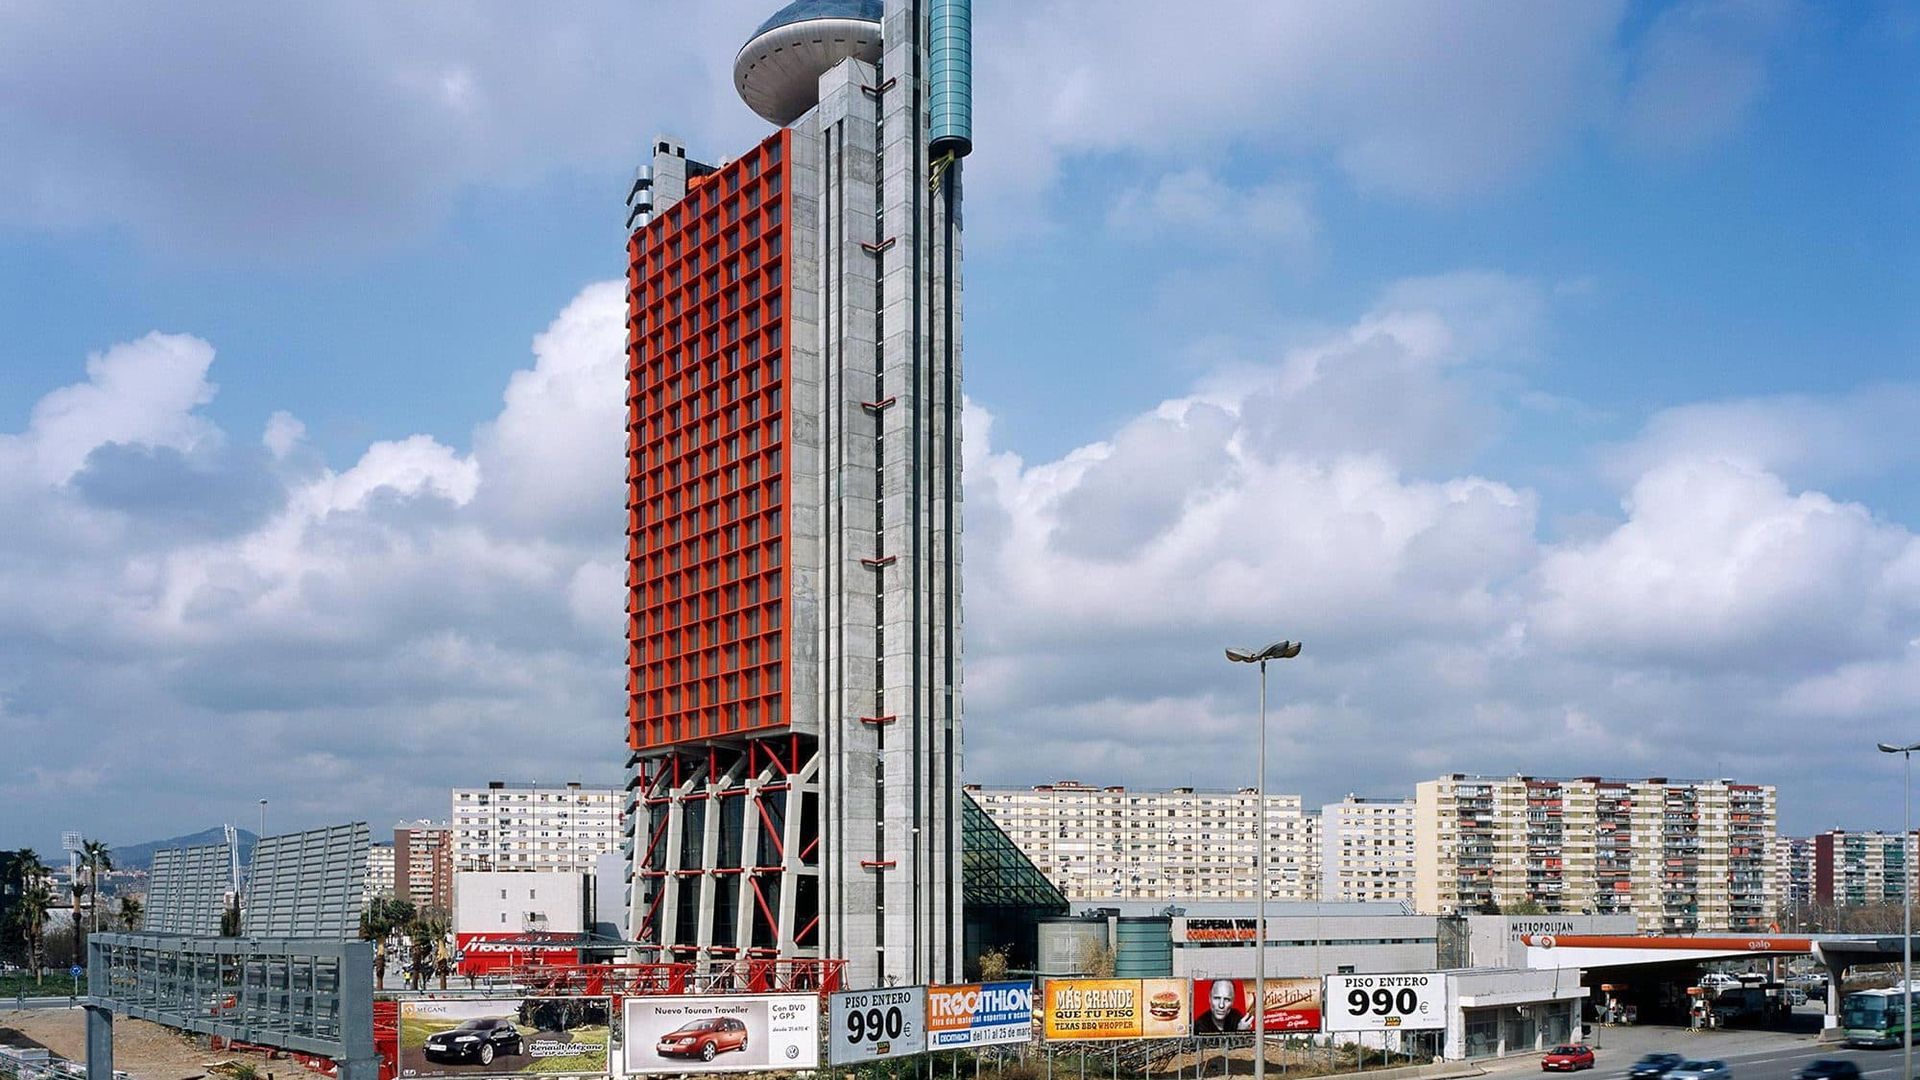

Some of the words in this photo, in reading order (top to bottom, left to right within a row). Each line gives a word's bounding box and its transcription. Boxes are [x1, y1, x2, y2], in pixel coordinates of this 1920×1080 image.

[1187, 919, 1234, 930] HESPERIA
[1235, 919, 1267, 930] TOW
[1511, 922, 1574, 933] METROPOLITAN
[1748, 940, 1771, 950] galp
[1345, 978, 1374, 988] PISO
[1379, 976, 1429, 987] ENTERO
[845, 994, 868, 1009] PISO
[872, 992, 911, 1006] ENTERO
[928, 989, 1031, 1017] TROCATHLON
[1056, 986, 1082, 1010] MÁS
[1085, 989, 1134, 1010] GRANDE
[1348, 988, 1417, 1016] 990
[1419, 1001, 1429, 1014] €
[684, 1006, 712, 1014] Touran
[714, 1006, 748, 1014] Traveller
[772, 1004, 787, 1012] Con
[779, 1012, 795, 1020] GPS
[1055, 1010, 1081, 1019] QUE
[1084, 1010, 1101, 1018] TU
[847, 1006, 902, 1044] 990
[903, 1021, 912, 1037] €
[1055, 1022, 1080, 1030] TEXAS
[1098, 1021, 1134, 1030] WHOPPER
[973, 1030, 982, 1041] del
[992, 1028, 998, 1039] al
[1008, 1027, 1015, 1038] de
